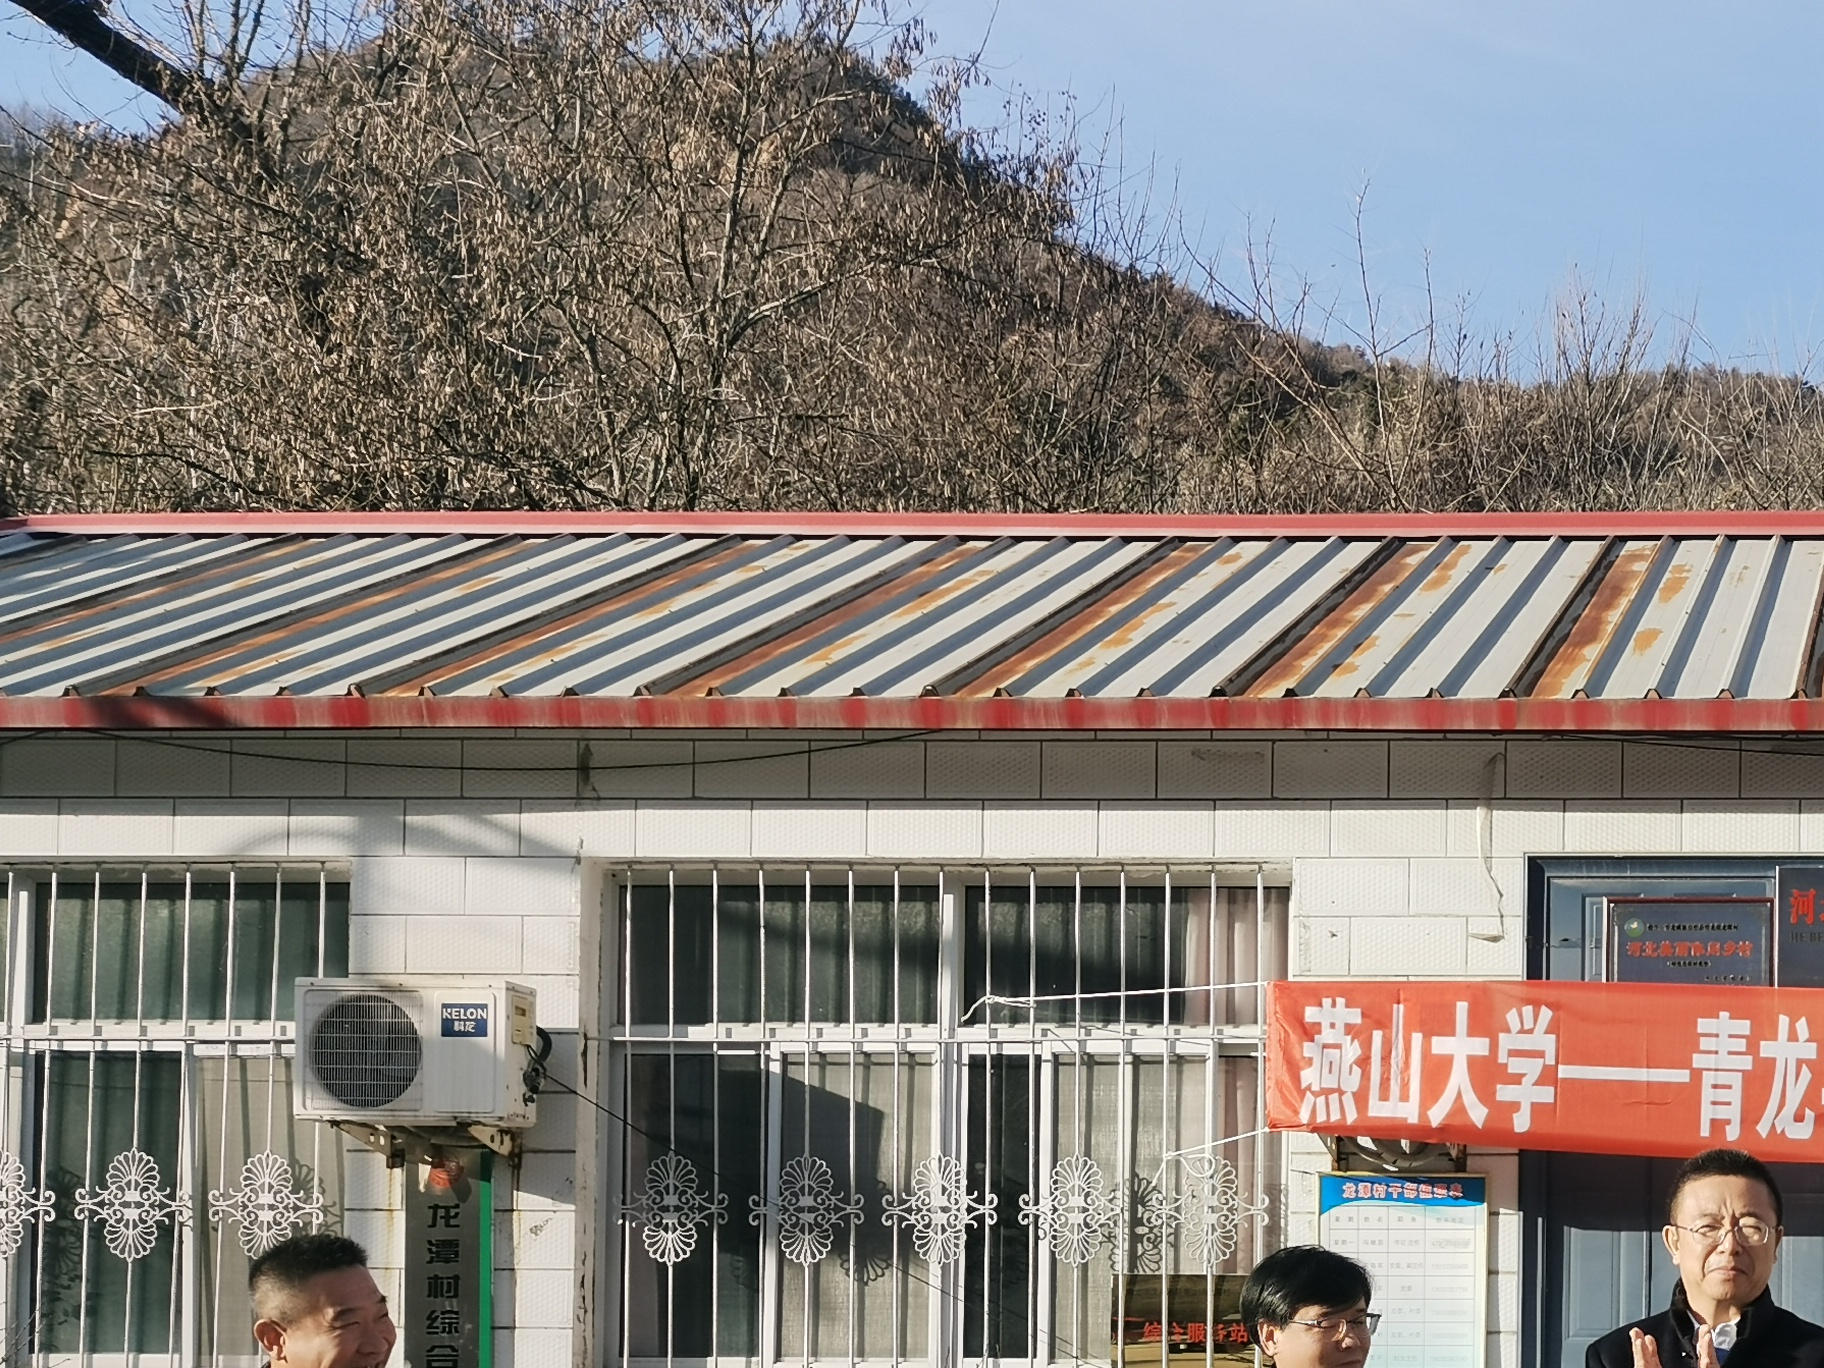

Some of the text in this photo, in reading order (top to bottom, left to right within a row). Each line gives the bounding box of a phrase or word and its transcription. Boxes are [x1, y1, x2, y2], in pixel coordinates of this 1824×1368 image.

[442, 1008, 487, 1019] KELON
[1342, 1182, 1463, 1198] 龙潭村干部值班表
